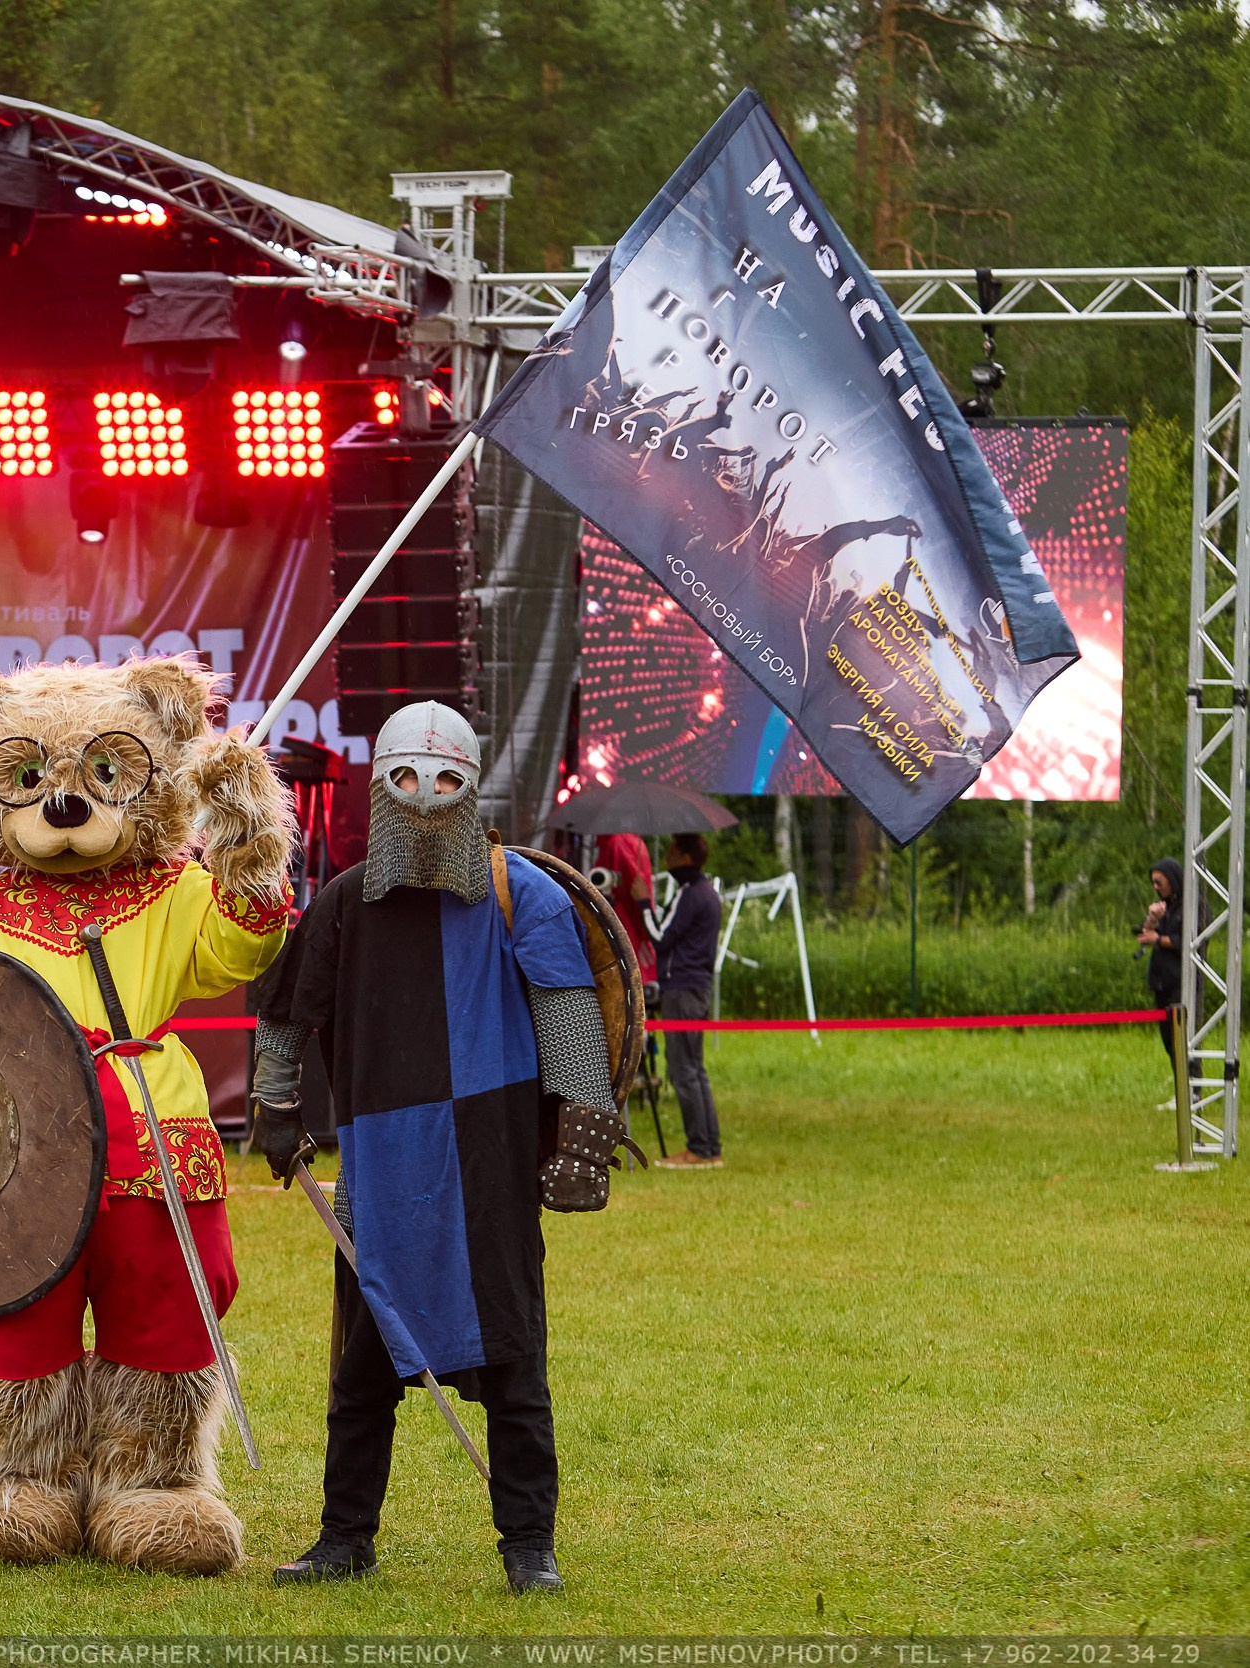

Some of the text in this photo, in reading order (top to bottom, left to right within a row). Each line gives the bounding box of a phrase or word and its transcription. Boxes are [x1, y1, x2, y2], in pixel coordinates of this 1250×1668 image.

[733, 247, 786, 310] НА
[653, 290, 839, 466] ПОВОРОТ
[569, 406, 689, 461] ГРЯЗЬ
[665, 553, 797, 686] «СОСНОВЫЙ БОР»
[848, 609, 936, 705] АРОМАТАМИ
[827, 643, 936, 769] ЭНЕРГИЯ И СИЛА
[857, 712, 923, 784] МУЗЫКИ
